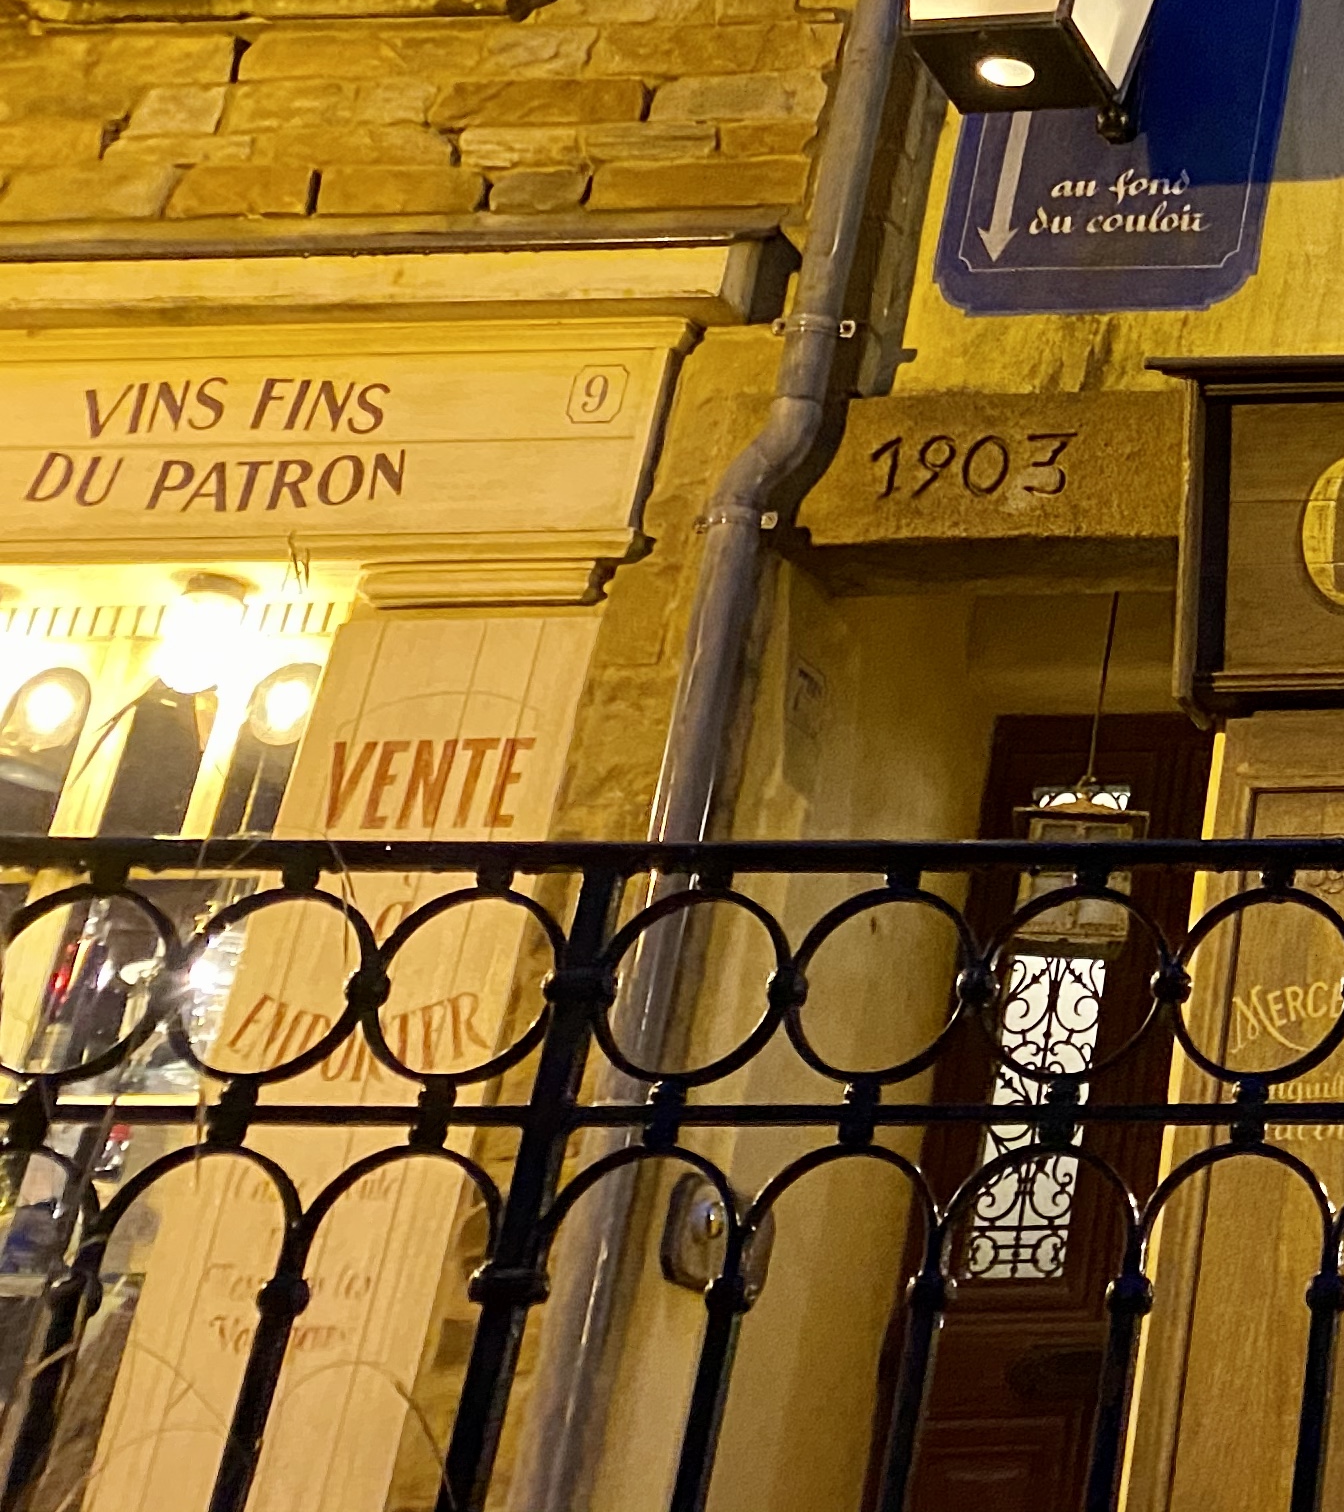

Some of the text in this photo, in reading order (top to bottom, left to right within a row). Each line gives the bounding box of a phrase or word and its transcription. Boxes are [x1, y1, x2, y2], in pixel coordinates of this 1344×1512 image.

[1028, 200, 1211, 235] du couloir
[1051, 168, 1191, 205] au fond
[83, 376, 392, 439] VINS FINS
[580, 373, 609, 413] 9
[25, 448, 407, 513] DU PATRON
[870, 432, 1078, 500] 1903
[325, 736, 537, 831] VENTE
